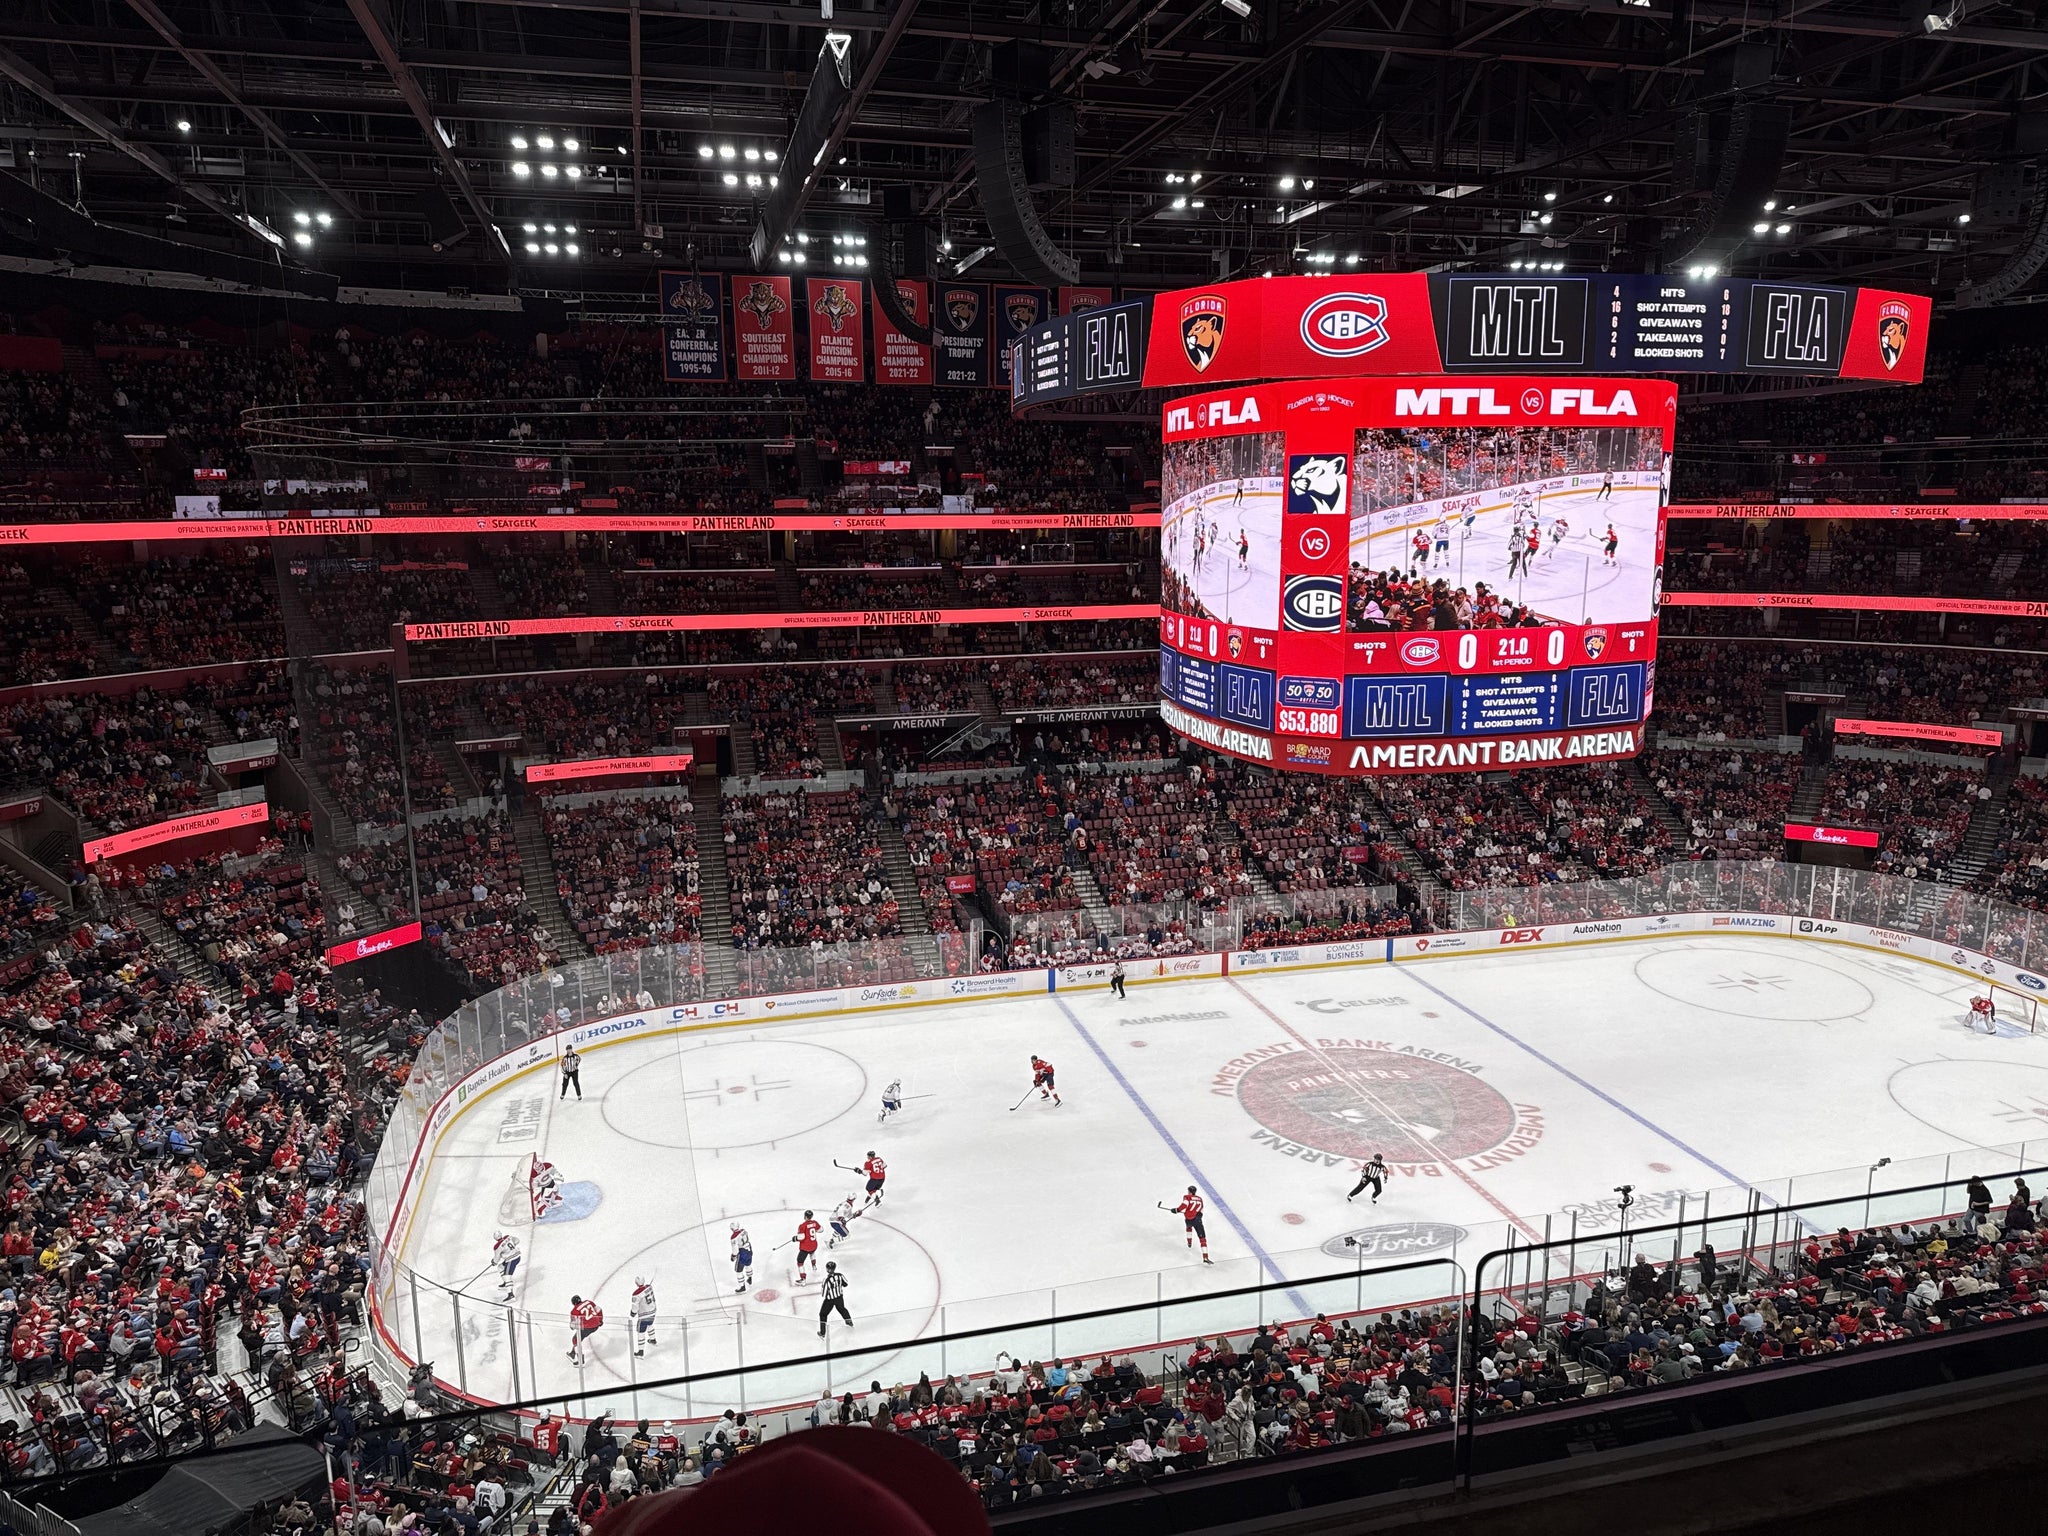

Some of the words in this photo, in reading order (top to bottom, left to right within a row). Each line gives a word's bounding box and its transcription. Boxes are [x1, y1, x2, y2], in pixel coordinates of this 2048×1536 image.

[1613, 285, 1620, 297] 4
[1660, 288, 1686, 298] HITS
[1723, 289, 1730, 301] 6
[1183, 295, 1223, 317] FLORIDA
[1611, 301, 1621, 313] 16
[1636, 303, 1661, 312] SHOT
[1661, 303, 1707, 313] ATTEMPTS
[1721, 304, 1730, 316] 18
[1470, 286, 1563, 356] MTL
[1612, 316, 1618, 328] 6
[1639, 318, 1702, 328] GIVEAWAYS
[1721, 319, 1727, 331] 3
[1763, 293, 1828, 362] FLA
[742, 333, 786, 343] SOUTHEAST
[820, 335, 854, 346] ATLANTIC
[1611, 331, 1618, 343] 2
[1637, 333, 1703, 343] TAKEAWAYS
[1720, 334, 1727, 345] 0
[748, 343, 782, 354] DIVISION
[821, 345, 853, 356] DIVISION
[886, 345, 919, 355] DIVISION
[1086, 312, 1130, 381] FLA
[672, 351, 718, 362] CHAMPIONS
[742, 353, 788, 364] CHAMPIONS
[948, 348, 975, 359] TROPHY
[1610, 346, 1616, 358] 4
[1634, 348, 1674, 358] BLOCKED
[1675, 348, 1703, 358] SHOTS
[1719, 349, 1726, 360] 7
[816, 355, 858, 366] CHAMPIONS
[881, 356, 924, 367] CHAMPIONS
[679, 363, 712, 374] 1995-96
[753, 365, 780, 375] 2011-12
[825, 367, 852, 377] 2015-16
[889, 368, 918, 378] 2021-22
[947, 370, 976, 381] 2021-22
[1395, 388, 1510, 416] MTL
[1525, 396, 1540, 408] VS
[1549, 388, 1639, 416] FLA
[1167, 406, 1194, 433] MTL
[1208, 397, 1261, 427] FLA
[1716, 505, 1796, 518] PANTHERLAND
[1904, 506, 1950, 516] SEATGEEK
[278, 519, 373, 535] PANTHERLAND
[492, 518, 537, 528] SEATGEEK
[692, 517, 775, 530] PANTHERLAND
[846, 518, 886, 527] SEATGEEK
[1063, 515, 1134, 527] PANTHERLAND
[1306, 538, 1324, 551] VS
[1770, 595, 1813, 606] SEATGEEK
[863, 611, 942, 624] PANTHERLAND
[1034, 609, 1073, 619] SEATGEEK
[629, 618, 674, 628] SEATGEEK
[416, 621, 510, 638] PANTHERLAND
[1621, 630, 1645, 638] SHOTS
[1208, 624, 1218, 657] 0
[1253, 636, 1273, 646] SHOTS
[1353, 641, 1387, 650] SHOTS
[1458, 633, 1478, 670] 0
[1498, 637, 1528, 656] 21.0
[1547, 630, 1565, 666] 0
[1366, 650, 1374, 664] 7
[1504, 656, 1533, 666] PERIOD
[1500, 676, 1522, 685] HITS
[1227, 673, 1262, 720] FLA
[1286, 684, 1302, 697] 50
[1316, 686, 1333, 698] 50
[1475, 687, 1500, 697] SHOT
[1500, 685, 1545, 696] ATTEMPTS
[1581, 673, 1629, 717] FLA
[1365, 684, 1431, 728] MTL
[1483, 697, 1537, 707] GIVEAWAYS
[1036, 713, 1055, 723] THE
[1057, 711, 1109, 722] AMERANT
[1110, 708, 1146, 720] VAULT
[1481, 707, 1538, 718] TAKEAWAYS
[892, 718, 946, 729] AMERANT
[1279, 709, 1338, 735] $53,880
[1474, 719, 1513, 729] BLOCKED
[1514, 717, 1543, 727] SHOTS
[677, 729, 689, 738] 132
[1191, 714, 1222, 747] BANK
[1221, 730, 1273, 761] ARENA
[1915, 727, 1957, 738] PANTHERLAND
[1350, 742, 1497, 769] AMERANT
[1500, 737, 1564, 764] BANK
[1565, 730, 1635, 758] ARENA
[261, 756, 276, 767] 130
[609, 761, 651, 770] PANTHERLAND
[24, 801, 40, 813] 129
[171, 817, 220, 834] PANTHERLAND
[1730, 917, 1776, 928] AMAZING
[1572, 923, 1622, 935] AutoNation
[1499, 928, 1546, 945] DEX
[1868, 928, 1912, 944] AMERANT
[1326, 943, 1364, 953] COMCAST
[1879, 938, 1900, 949] BANK
[1326, 951, 1364, 961] BUSINESS
[966, 979, 995, 987] Broward
[995, 976, 1016, 984] Health
[2020, 975, 2041, 990] Ford
[860, 988, 898, 1001] Surfside
[1341, 996, 1409, 1010] CELSIUS
[1118, 1009, 1228, 1026] AutoNation
[587, 1018, 647, 1038] HONDA
[1210, 1041, 1294, 1098] AMERANT
[1317, 1037, 1393, 1052] BANK
[1398, 1043, 1483, 1075] ARENA
[467, 1073, 488, 1094] Baptist
[488, 1061, 511, 1082] Health
[1287, 1068, 1411, 1093] PANTHERS
[1249, 1128, 1343, 1168] ARENA
[1362, 1226, 1438, 1256] Ford
